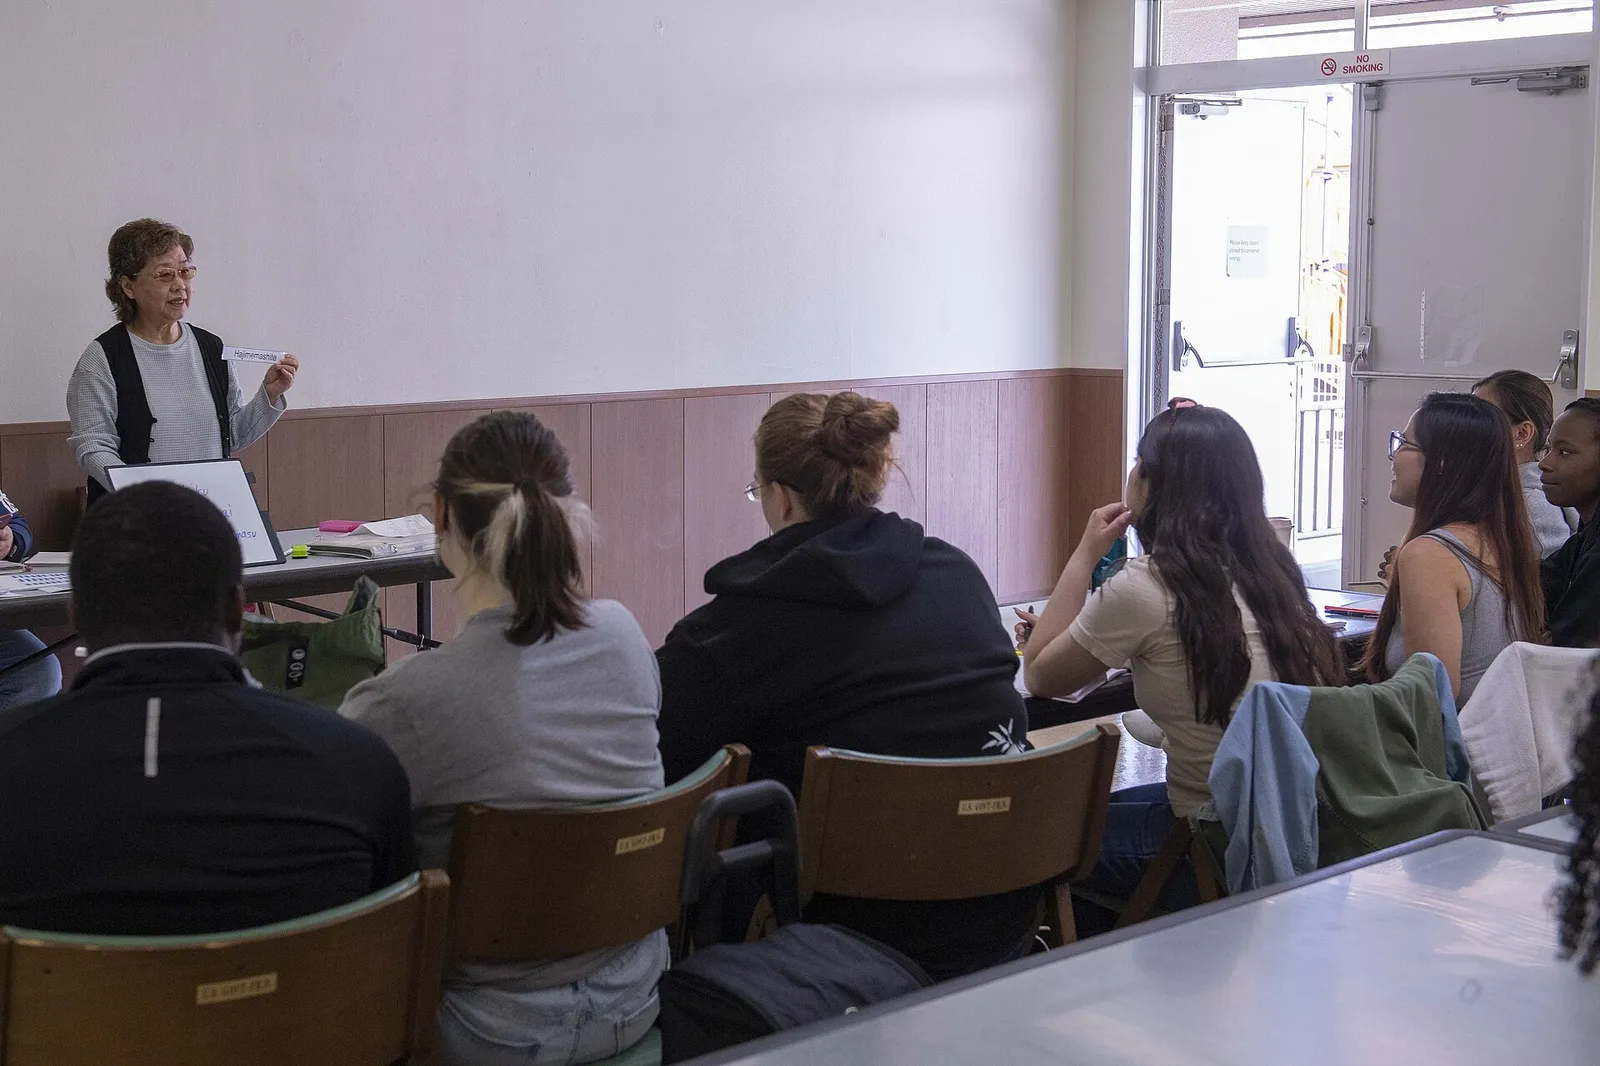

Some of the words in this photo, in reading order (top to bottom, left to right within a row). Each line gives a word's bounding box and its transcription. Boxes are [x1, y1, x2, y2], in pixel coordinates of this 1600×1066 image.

[1356, 54, 1369, 63] NO
[1342, 63, 1384, 74] SMOKING
[234, 349, 278, 361] Hajimemashite
